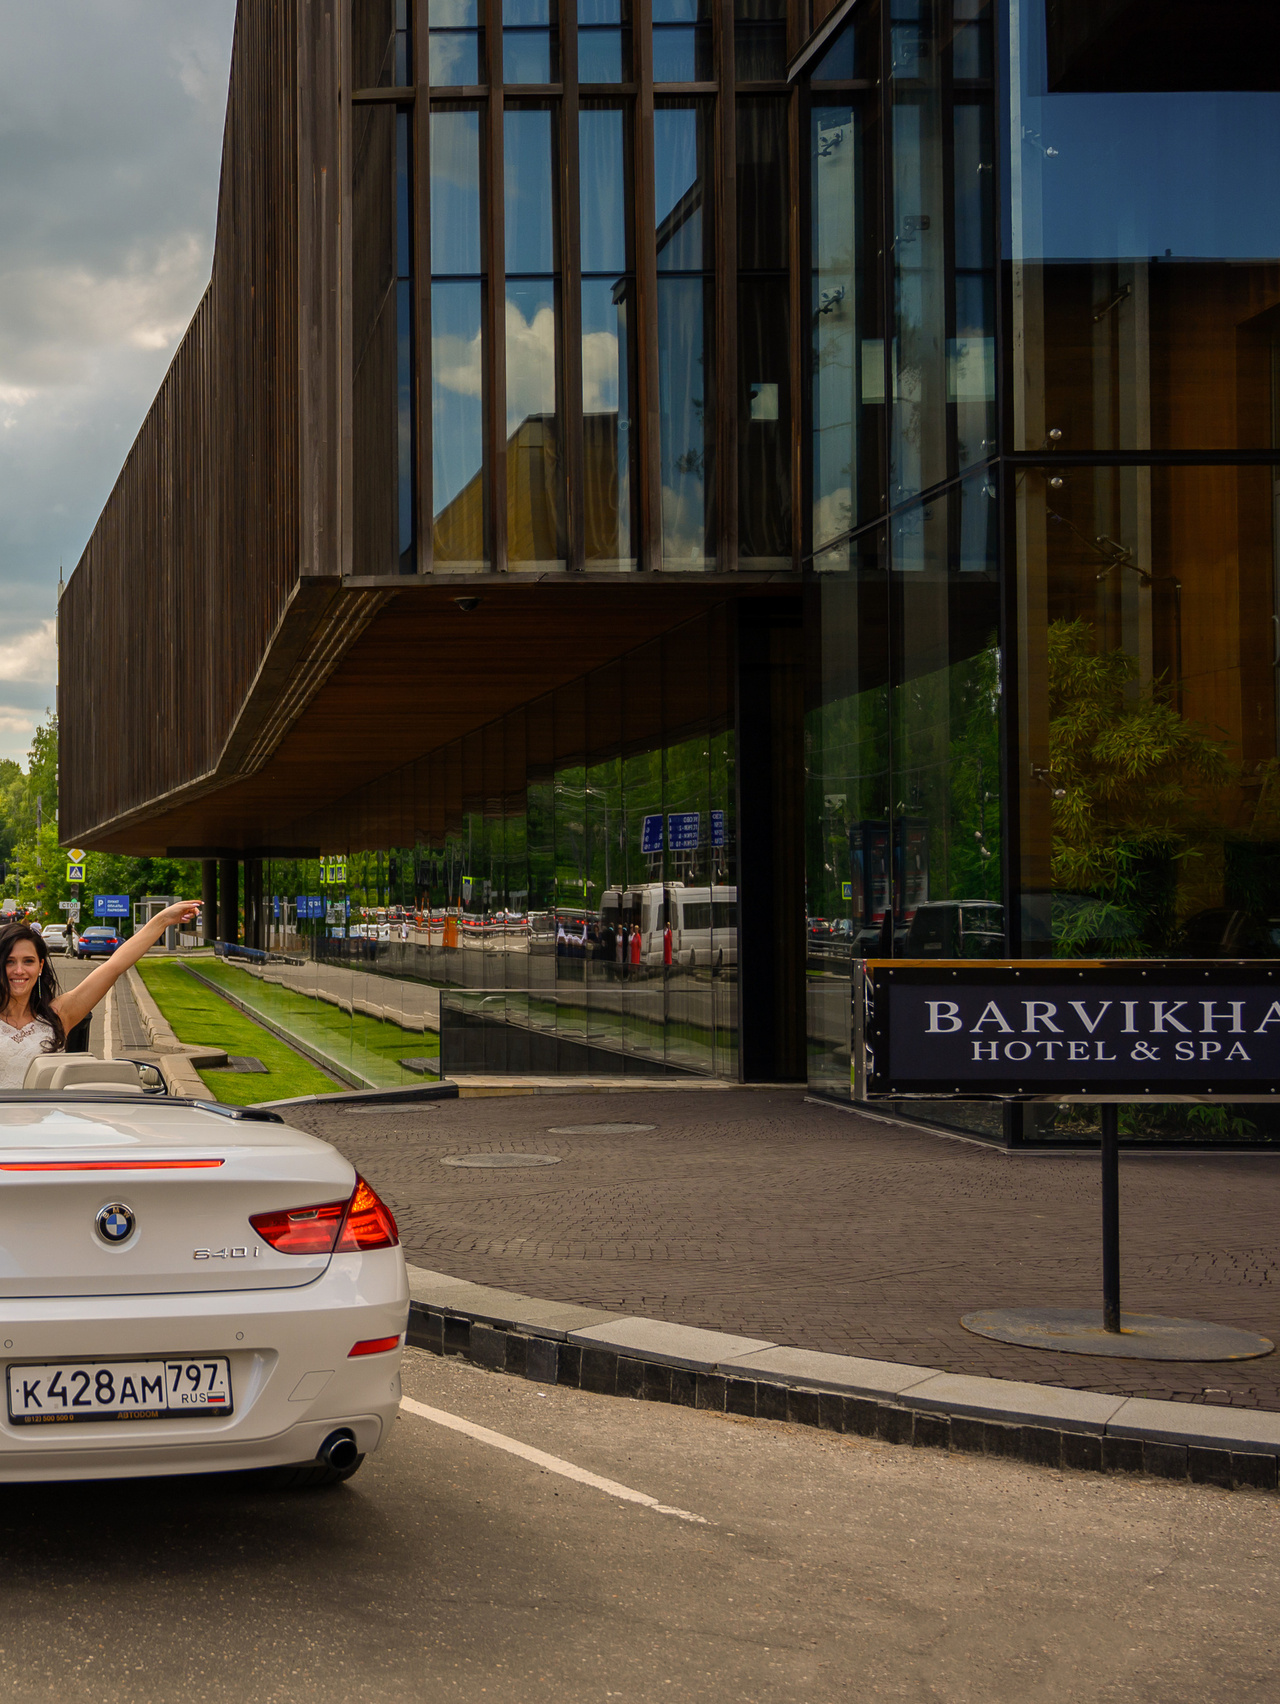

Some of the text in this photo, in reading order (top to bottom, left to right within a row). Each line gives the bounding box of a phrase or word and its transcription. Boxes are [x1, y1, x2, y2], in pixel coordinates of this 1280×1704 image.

[923, 1000, 1280, 1034] BARVIKHA
[971, 1040, 1252, 1062] HOTEL & SPA
[101, 1207, 131, 1219] BMW
[168, 1363, 218, 1392] 797
[181, 1392, 207, 1404] RUS
[43, 1415, 55, 1423] 500
